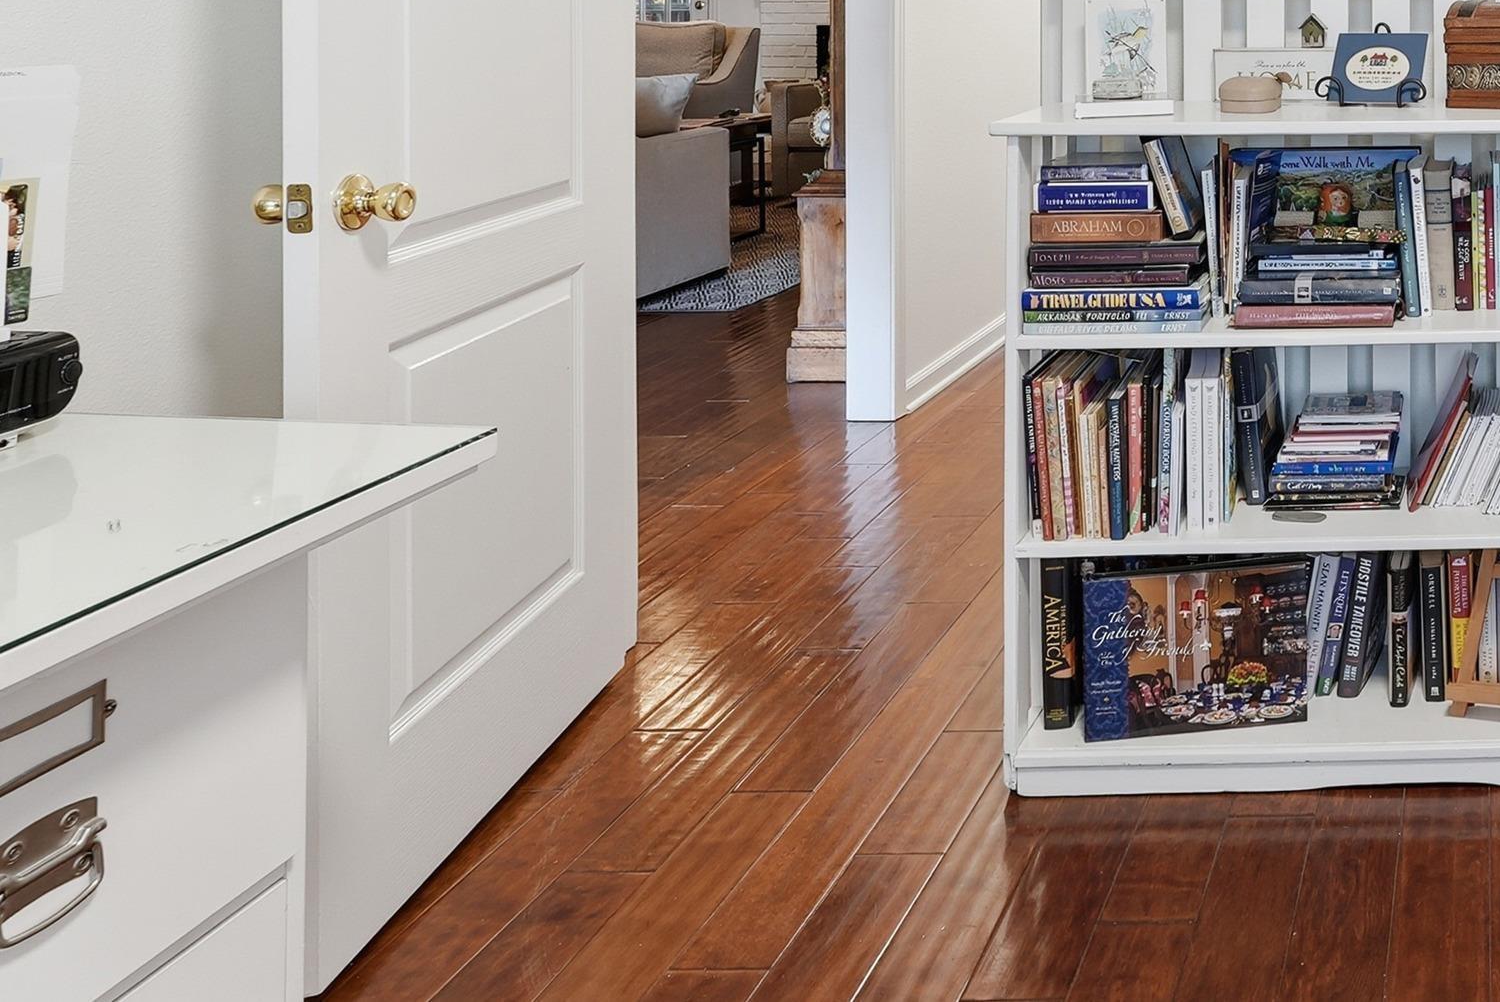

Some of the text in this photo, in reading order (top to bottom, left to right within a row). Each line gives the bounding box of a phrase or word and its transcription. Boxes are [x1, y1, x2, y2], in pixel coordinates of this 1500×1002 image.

[1300, 156, 1329, 170] Walk
[1330, 156, 1352, 169] with
[1355, 156, 1375, 169] Me
[1050, 220, 1123, 233] ABRAHAM
[1034, 253, 1071, 263] JOSEPH
[1033, 275, 1066, 286] MOSES
[1040, 292, 1166, 309] TRAVEL GUIDE USA
[1037, 312, 1083, 322] ARKANSAS
[1085, 311, 1131, 321] PORTFOLIO
[1163, 311, 1190, 320] ERNST
[1161, 323, 1187, 332] ERNST
[1162, 406, 1171, 473] COLORING BOOK
[1319, 561, 1331, 587] SEAN
[1428, 573, 1436, 609] ORWELL
[1311, 589, 1325, 633] HANNITY
[1333, 592, 1346, 617] ROLL!
[1346, 558, 1373, 658] HOSTILE TAKEOVER
[1107, 610, 1128, 624] The
[1044, 595, 1062, 672] AMERICA
[1091, 616, 1162, 648] Gathering
[1137, 639, 1197, 662] Friends
